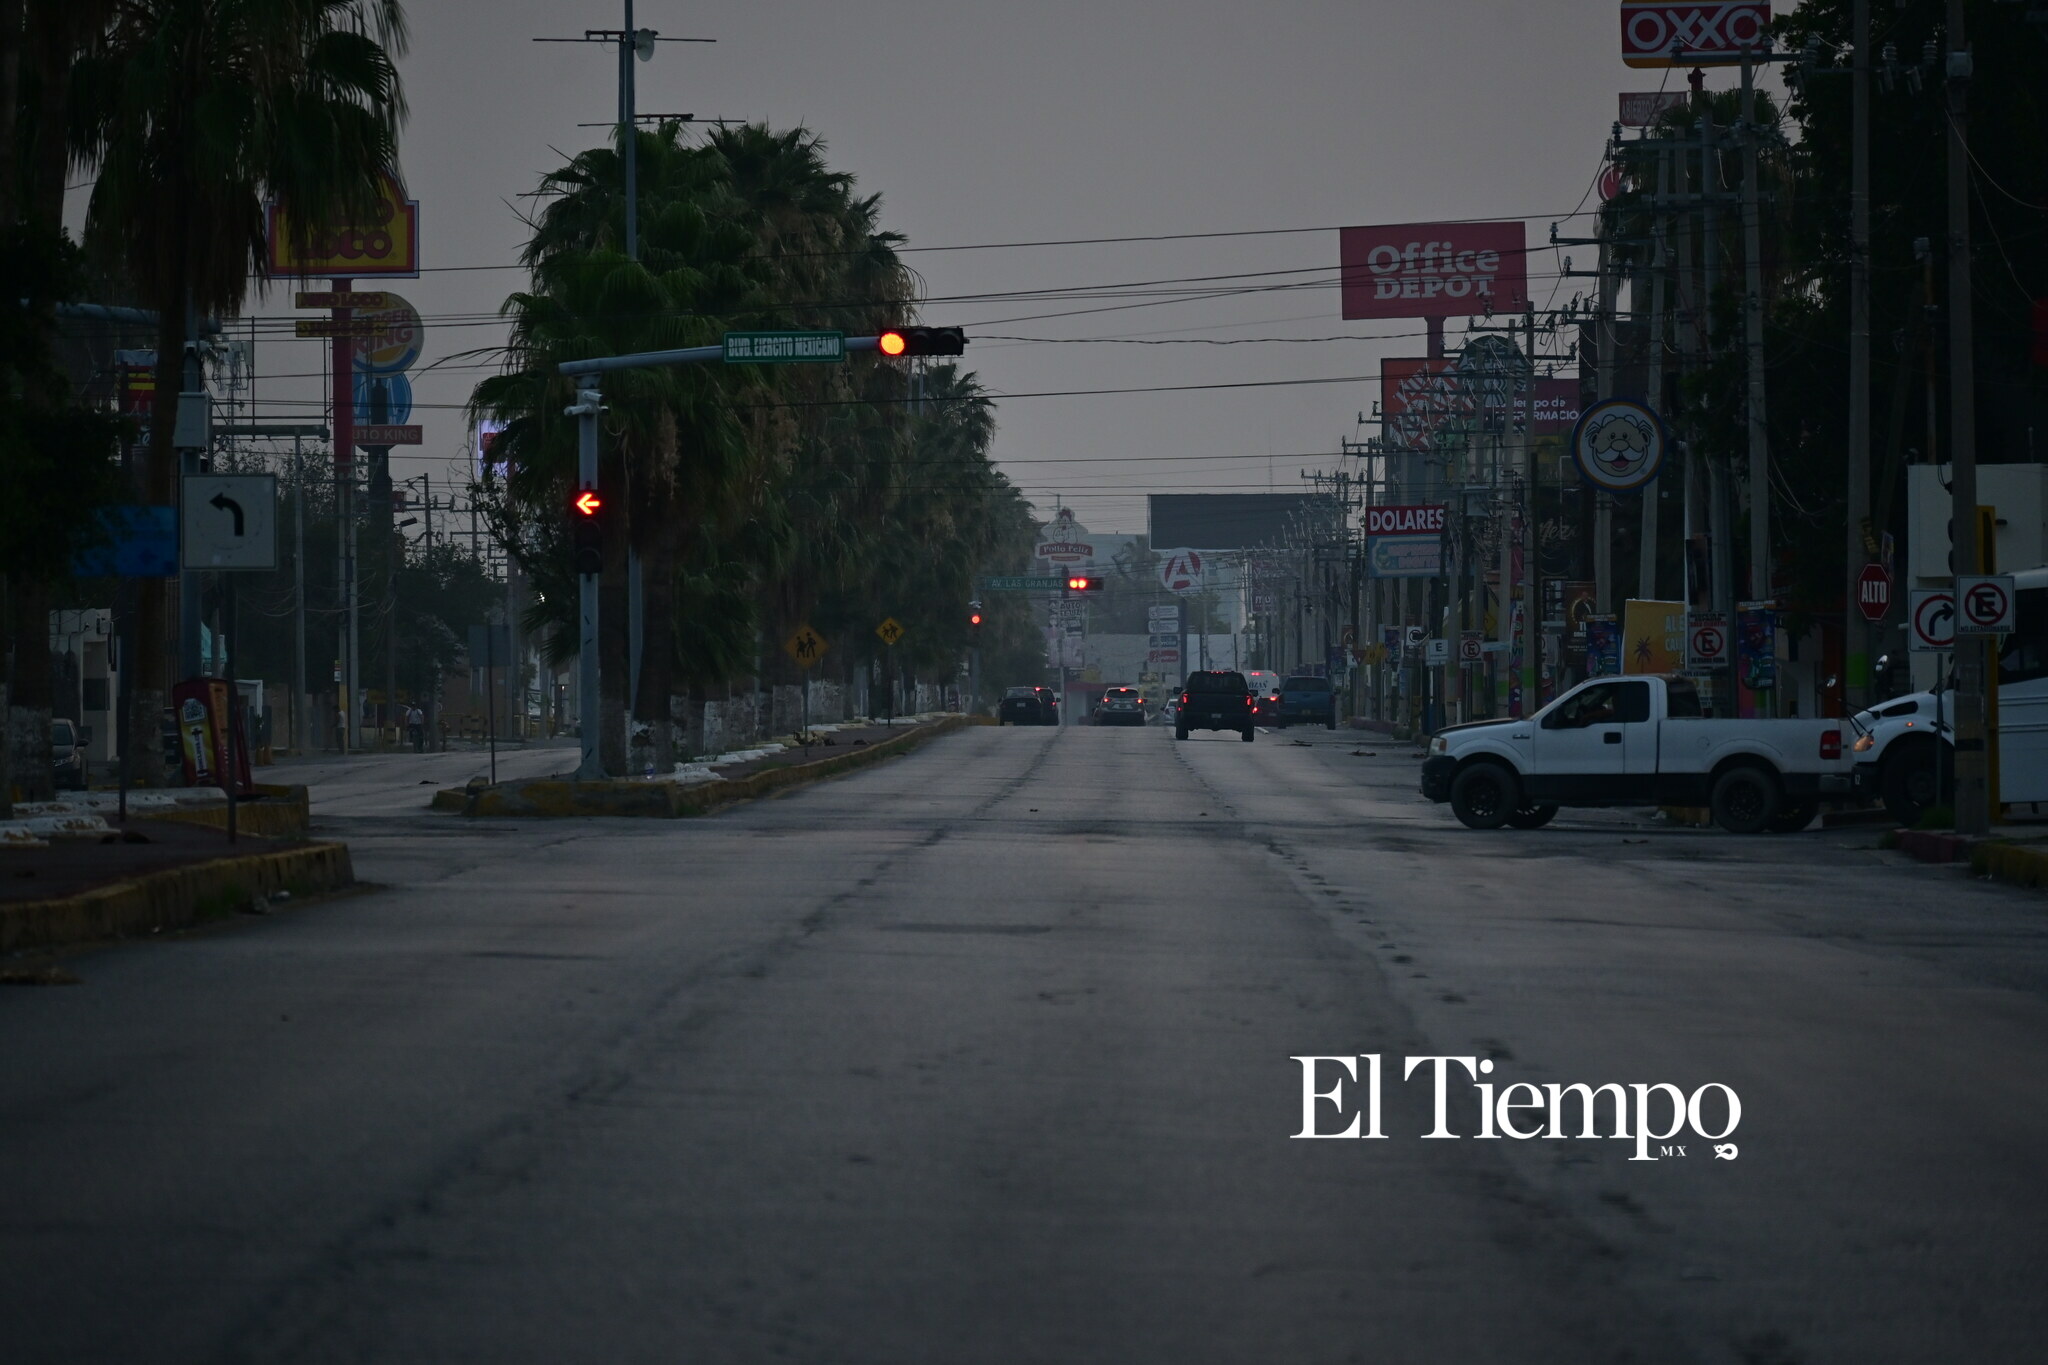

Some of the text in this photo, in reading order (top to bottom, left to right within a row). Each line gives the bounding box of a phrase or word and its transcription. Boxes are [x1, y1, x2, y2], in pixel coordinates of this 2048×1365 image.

[1627, 7, 1766, 51] OXXO
[1367, 241, 1500, 275] Office
[1373, 274, 1495, 300] DEPOT
[728, 336, 839, 357] BLVD. EJERCITO MEXICANO
[352, 429, 419, 441] UTO KING
[1369, 508, 1445, 532] DOLARES
[1043, 545, 1066, 553] Pollo
[1006, 579, 1022, 588] LAS
[1025, 579, 1064, 588] GRANJAS
[1861, 580, 1887, 604] ALTO
